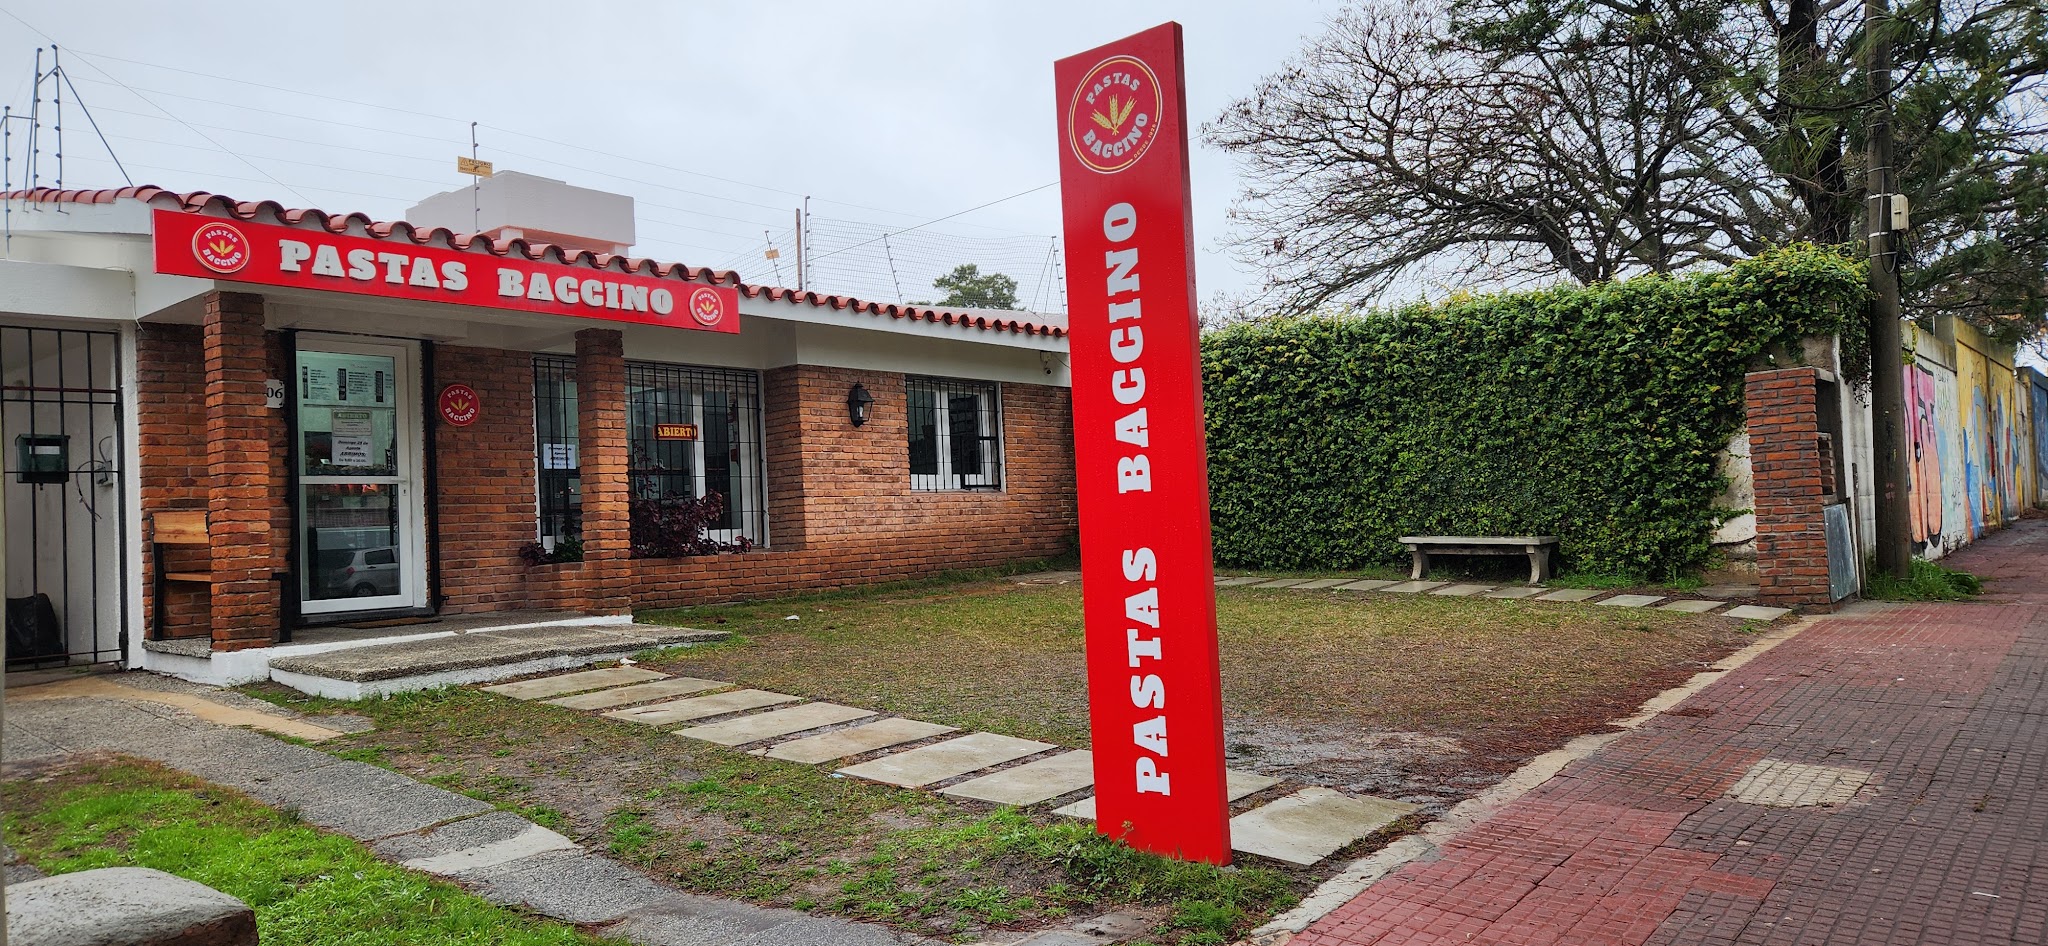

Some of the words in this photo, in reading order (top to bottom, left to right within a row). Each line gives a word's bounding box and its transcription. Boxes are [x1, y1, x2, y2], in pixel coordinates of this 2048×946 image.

[1086, 72, 1140, 105] PASTAS
[1083, 113, 1148, 158] BACCINO
[205, 229, 238, 243] PASTAS
[202, 248, 242, 266] BACCINO
[278, 239, 469, 291] PASTAS
[497, 267, 673, 315] BACCINO
[698, 293, 717, 303] PASTAS
[1103, 202, 1152, 494] BACCINO
[266, 387, 284, 399] 06
[447, 389, 473, 400] PASTAS
[445, 407, 475, 421] BACCINO
[657, 426, 697, 437] ABIERTO
[1122, 547, 1171, 796] PASTAS
